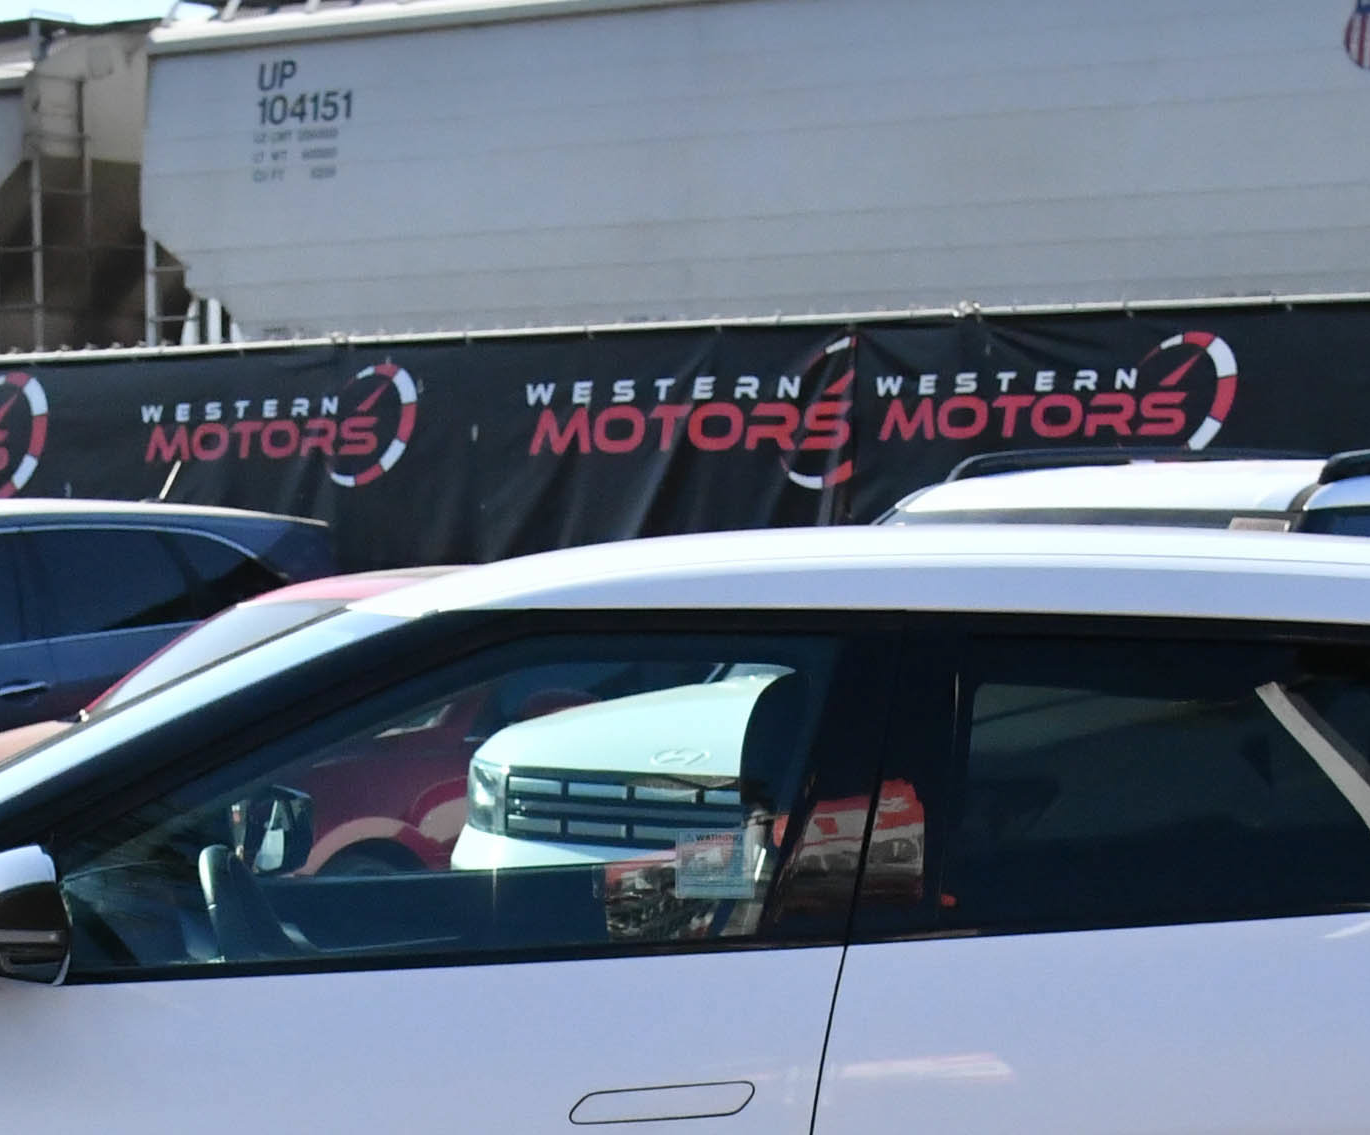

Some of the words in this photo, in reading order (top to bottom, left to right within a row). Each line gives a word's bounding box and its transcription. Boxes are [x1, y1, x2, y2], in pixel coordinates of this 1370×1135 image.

[257, 59, 298, 92] UP
[257, 89, 353, 126] 104151
[526, 375, 801, 405] WESTERN
[876, 367, 1138, 397] WESTERN
[140, 396, 339, 424] WESTERN
[879, 391, 1187, 441] MOTORS
[145, 415, 378, 462] MOTORS
[530, 401, 853, 457] MOTORS
